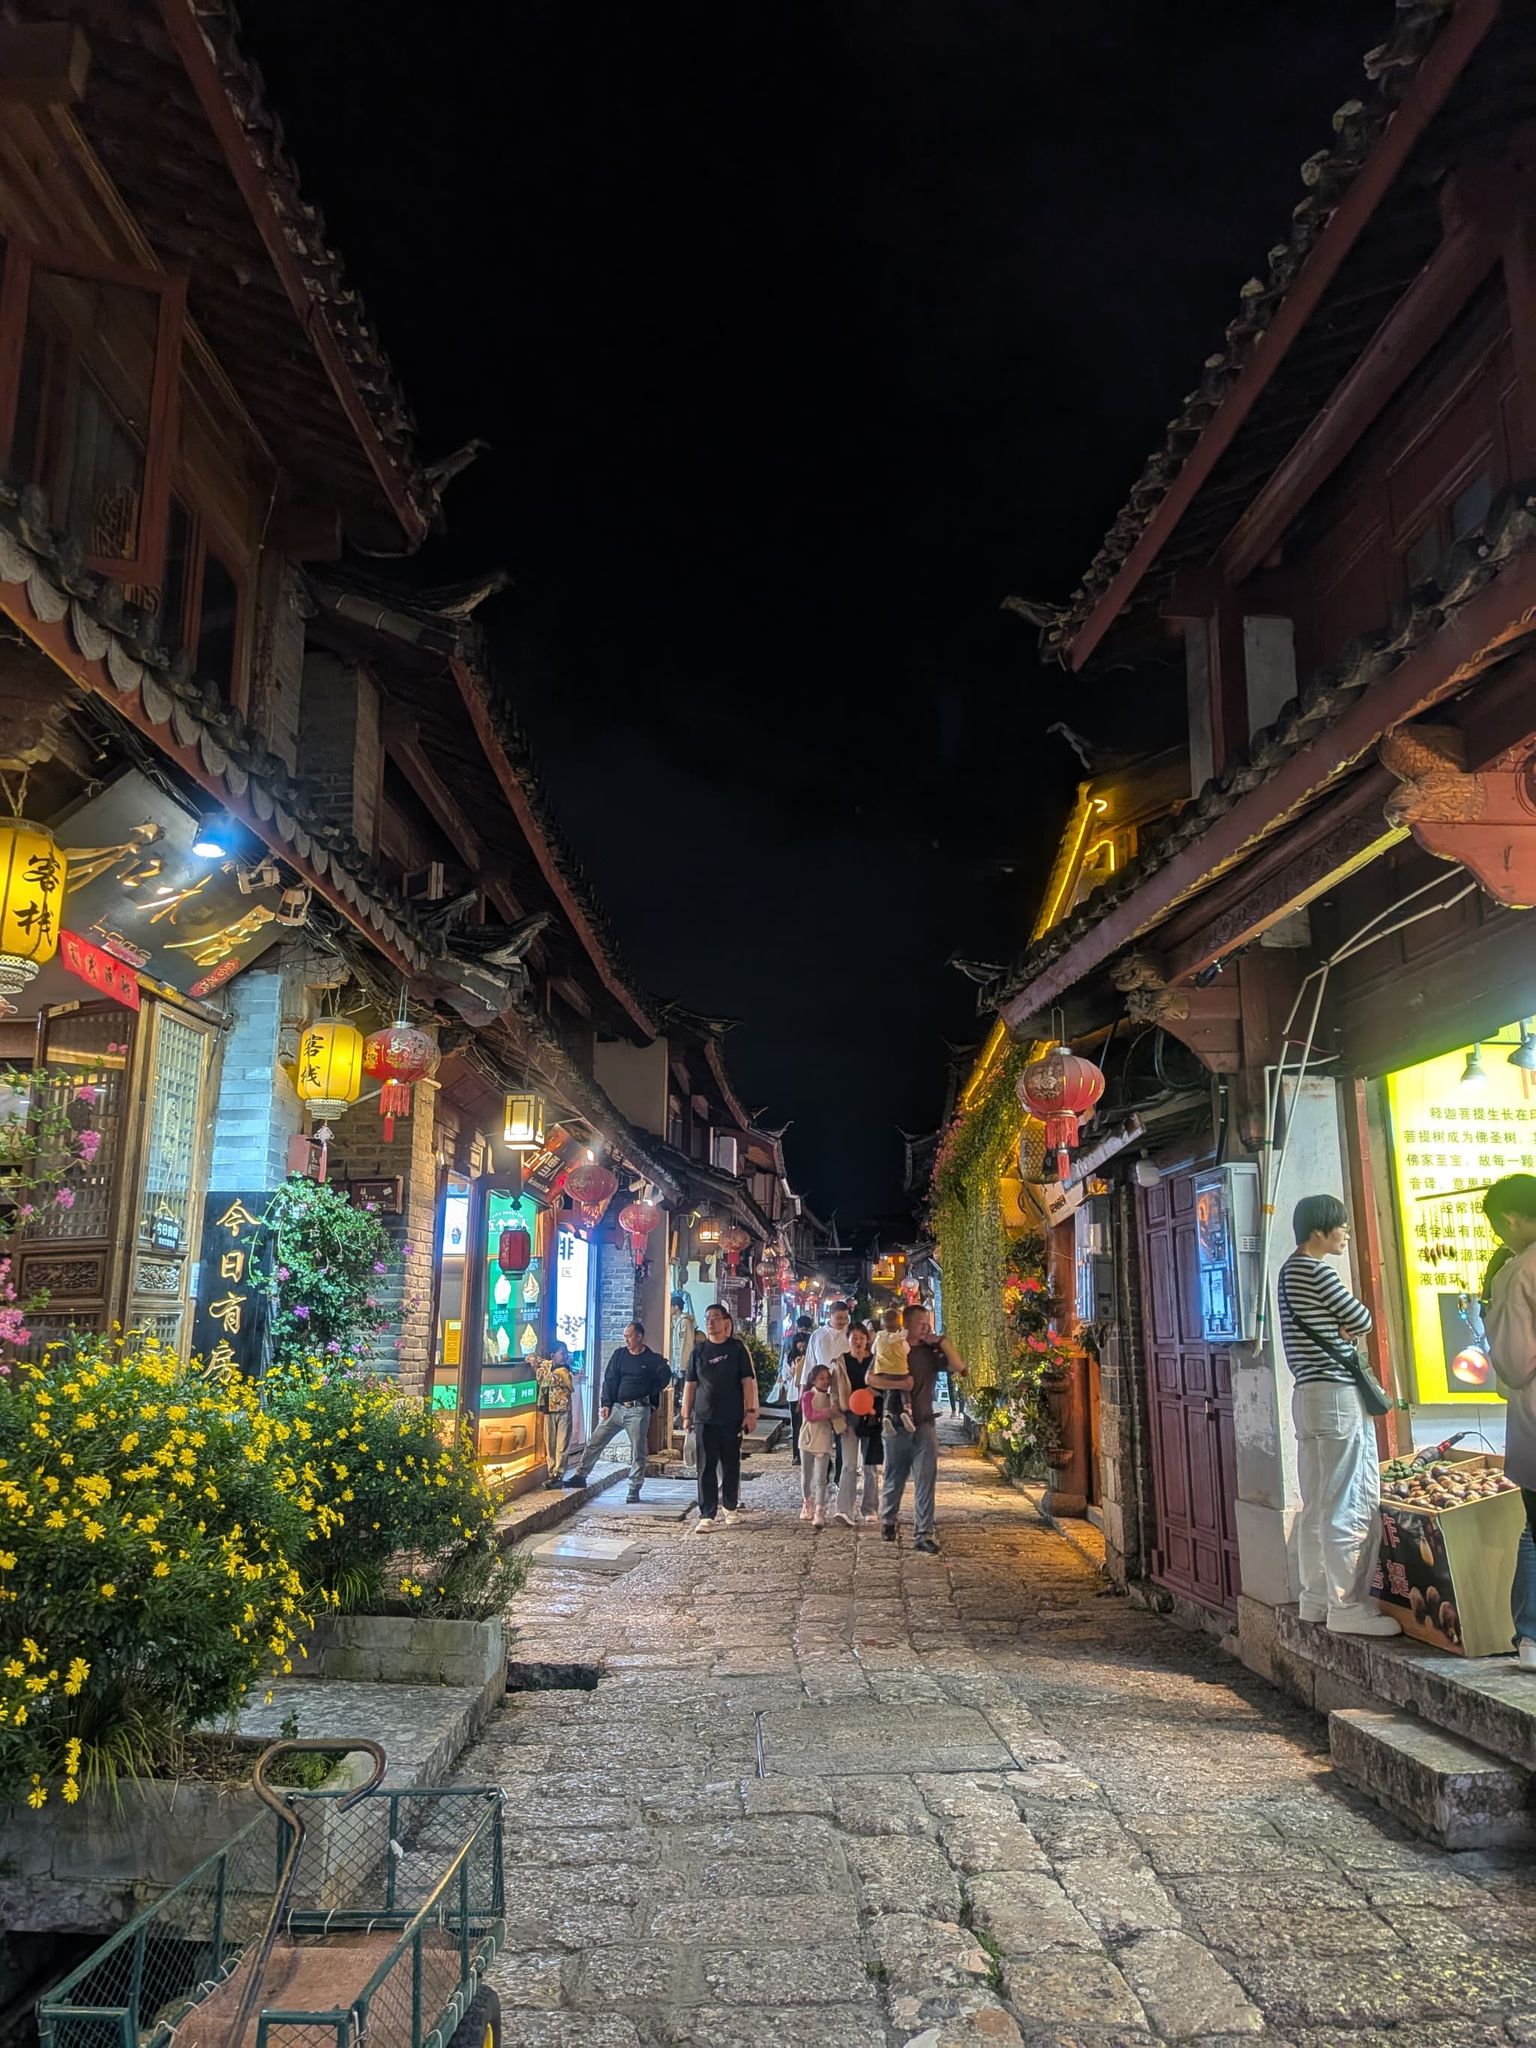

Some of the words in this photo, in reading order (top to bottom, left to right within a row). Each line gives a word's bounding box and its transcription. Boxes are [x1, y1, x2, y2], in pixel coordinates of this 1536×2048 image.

[13, 853, 61, 947] 客栈
[301, 1034, 325, 1087] 客栈
[1415, 1224, 1493, 1238] 使学业有成
[202, 1198, 262, 1384] 今日有房
